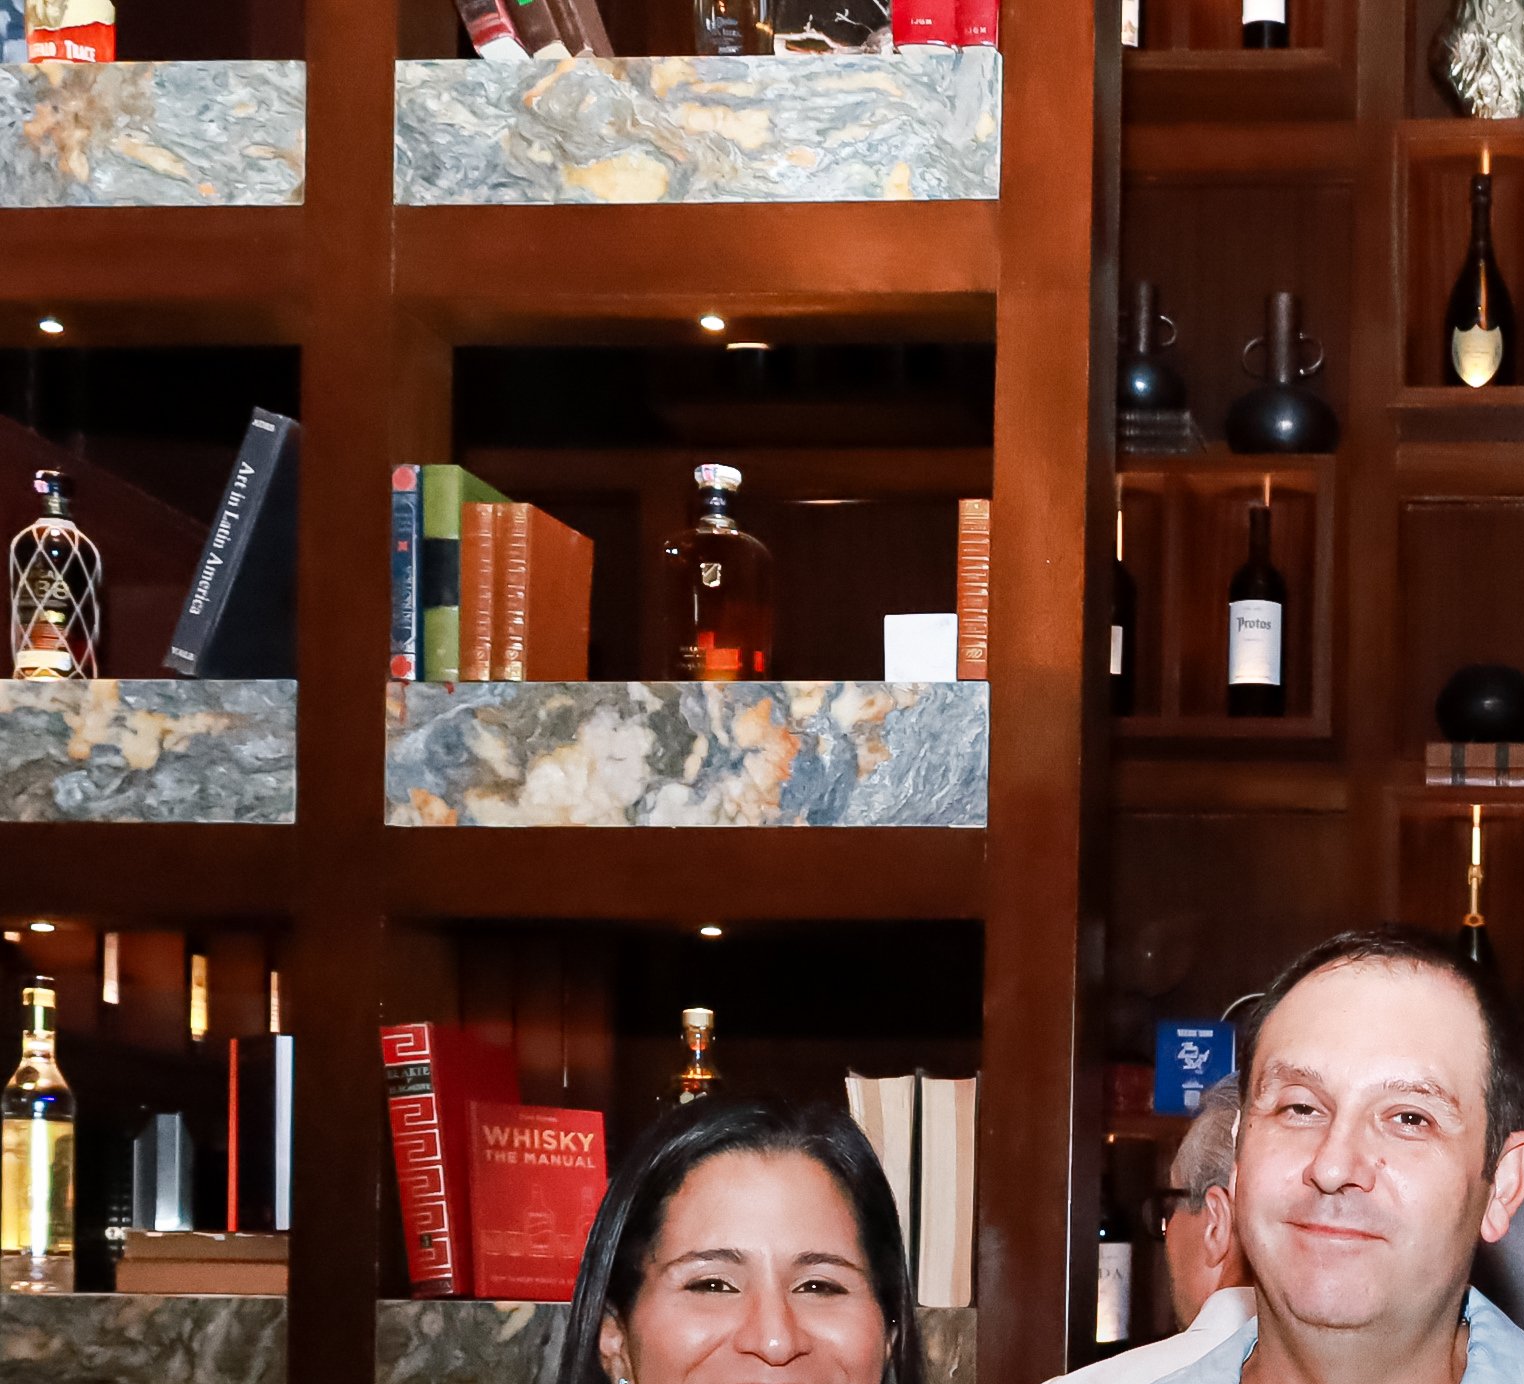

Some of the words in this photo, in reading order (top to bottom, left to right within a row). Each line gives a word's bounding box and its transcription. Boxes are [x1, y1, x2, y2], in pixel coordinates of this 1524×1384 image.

[234, 461, 255, 488] Art
[227, 491, 246, 507] in
[213, 510, 239, 548] Latin
[189, 552, 224, 614] America
[1236, 617, 1272, 632] Protos
[482, 1125, 594, 1152] WHISKY
[485, 1149, 517, 1164] THE
[524, 1152, 597, 1168] MANUAL
